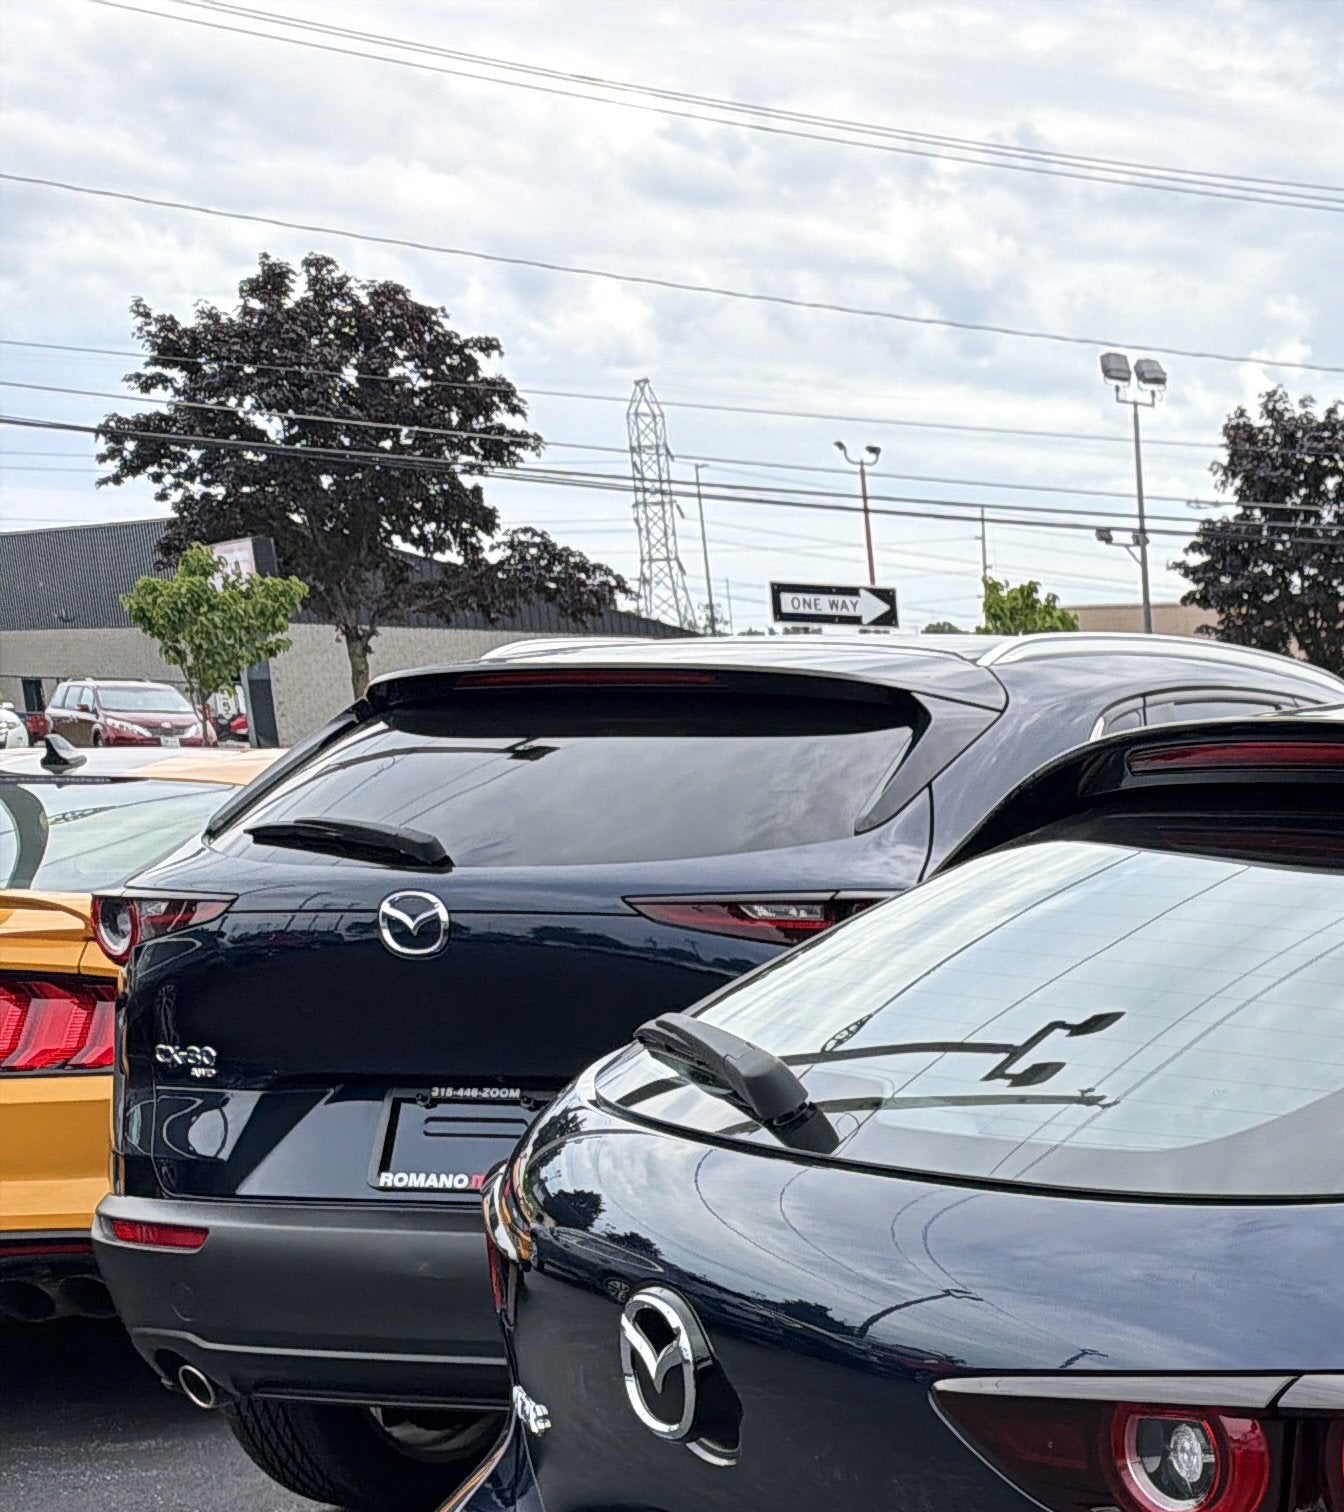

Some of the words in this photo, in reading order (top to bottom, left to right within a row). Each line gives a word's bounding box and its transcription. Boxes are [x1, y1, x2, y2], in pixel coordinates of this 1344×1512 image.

[791, 597, 822, 611] ONE
[828, 599, 859, 612] WAY
[379, 1172, 469, 1188] ROMANO
